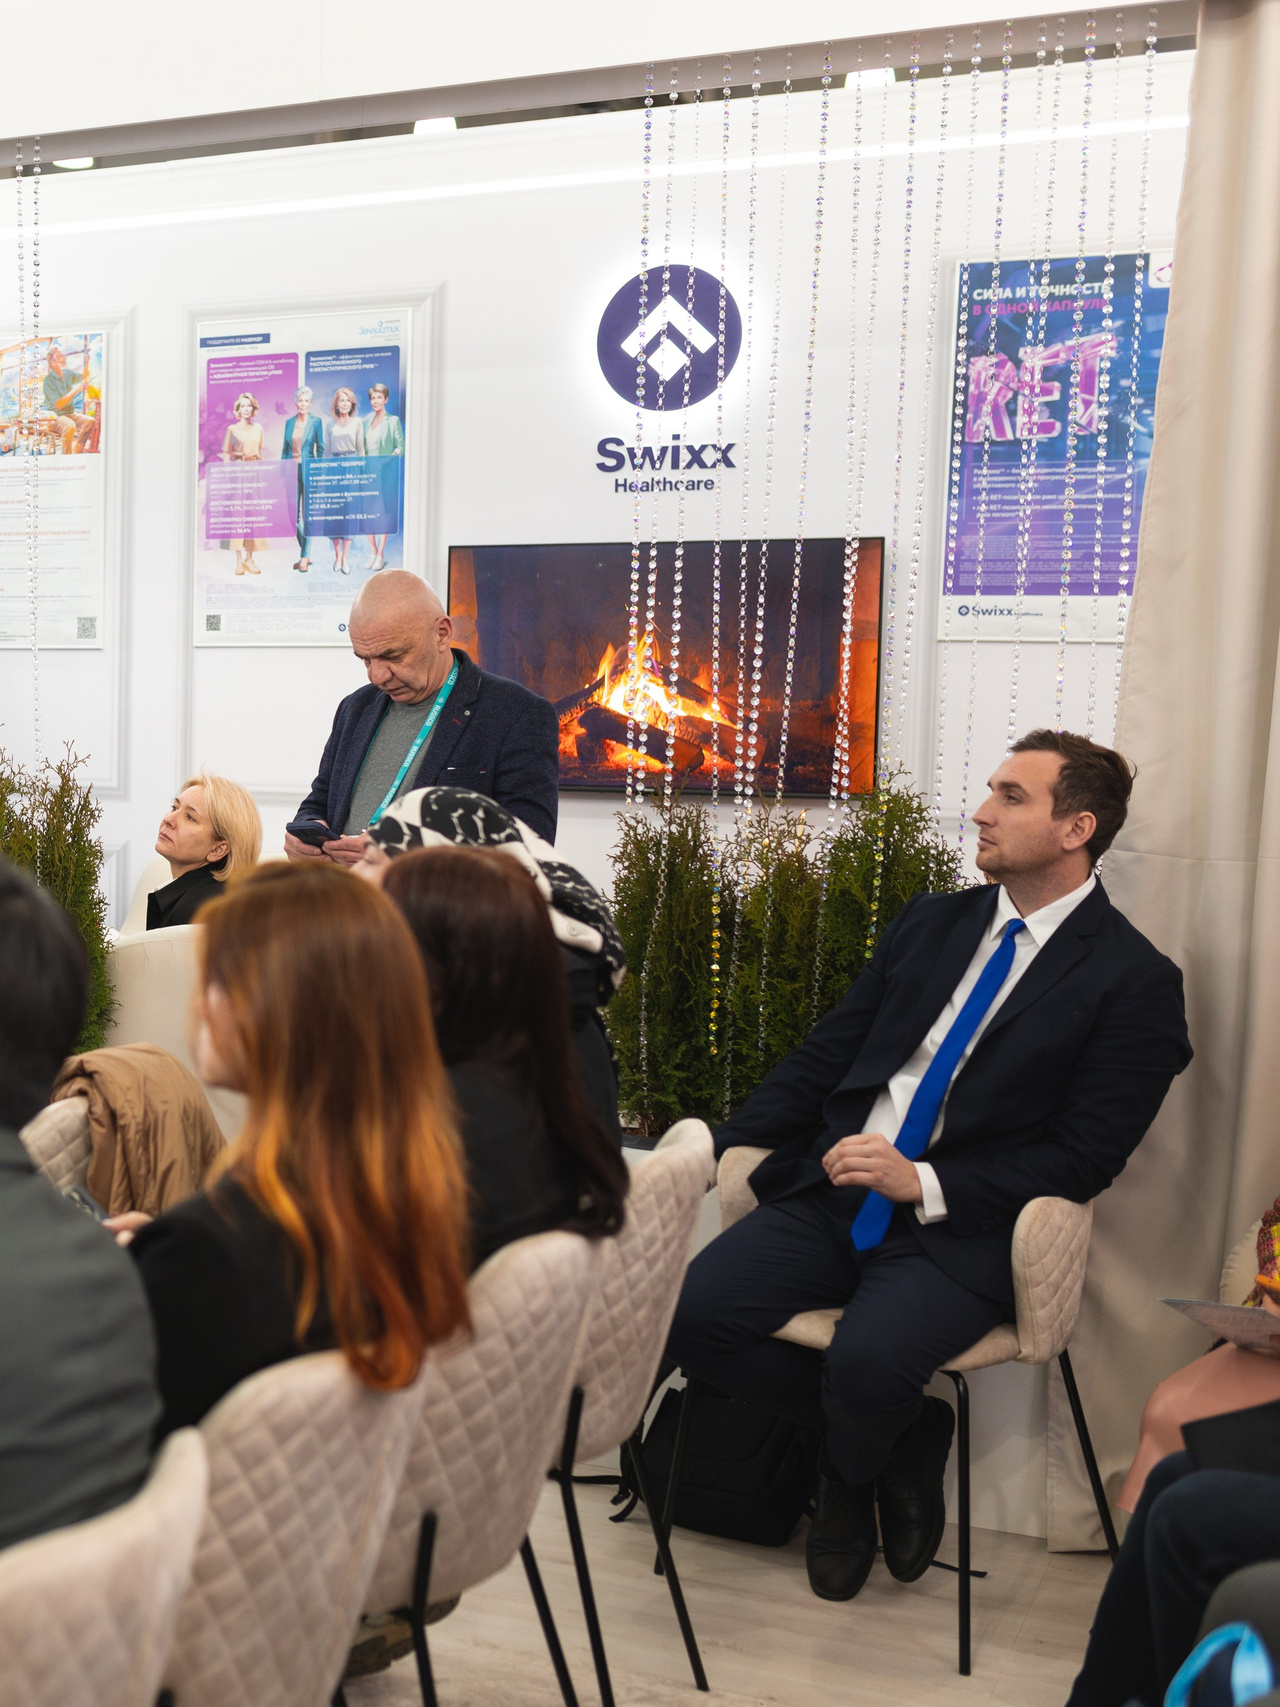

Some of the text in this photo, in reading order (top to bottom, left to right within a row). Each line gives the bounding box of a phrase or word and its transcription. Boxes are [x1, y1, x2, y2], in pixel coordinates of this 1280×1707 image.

[973, 287, 1013, 300] СИЛА
[1015, 286, 1026, 299] И
[972, 304, 981, 316] В
[965, 331, 1118, 443] RET
[596, 434, 736, 473] Swixx
[614, 477, 715, 493] Healthcare
[972, 605, 1013, 616] Swixx
[426, 704, 441, 726] RUSSCO
[404, 746, 418, 767] RUSSCO
[381, 788, 396, 809] RUSSCO
